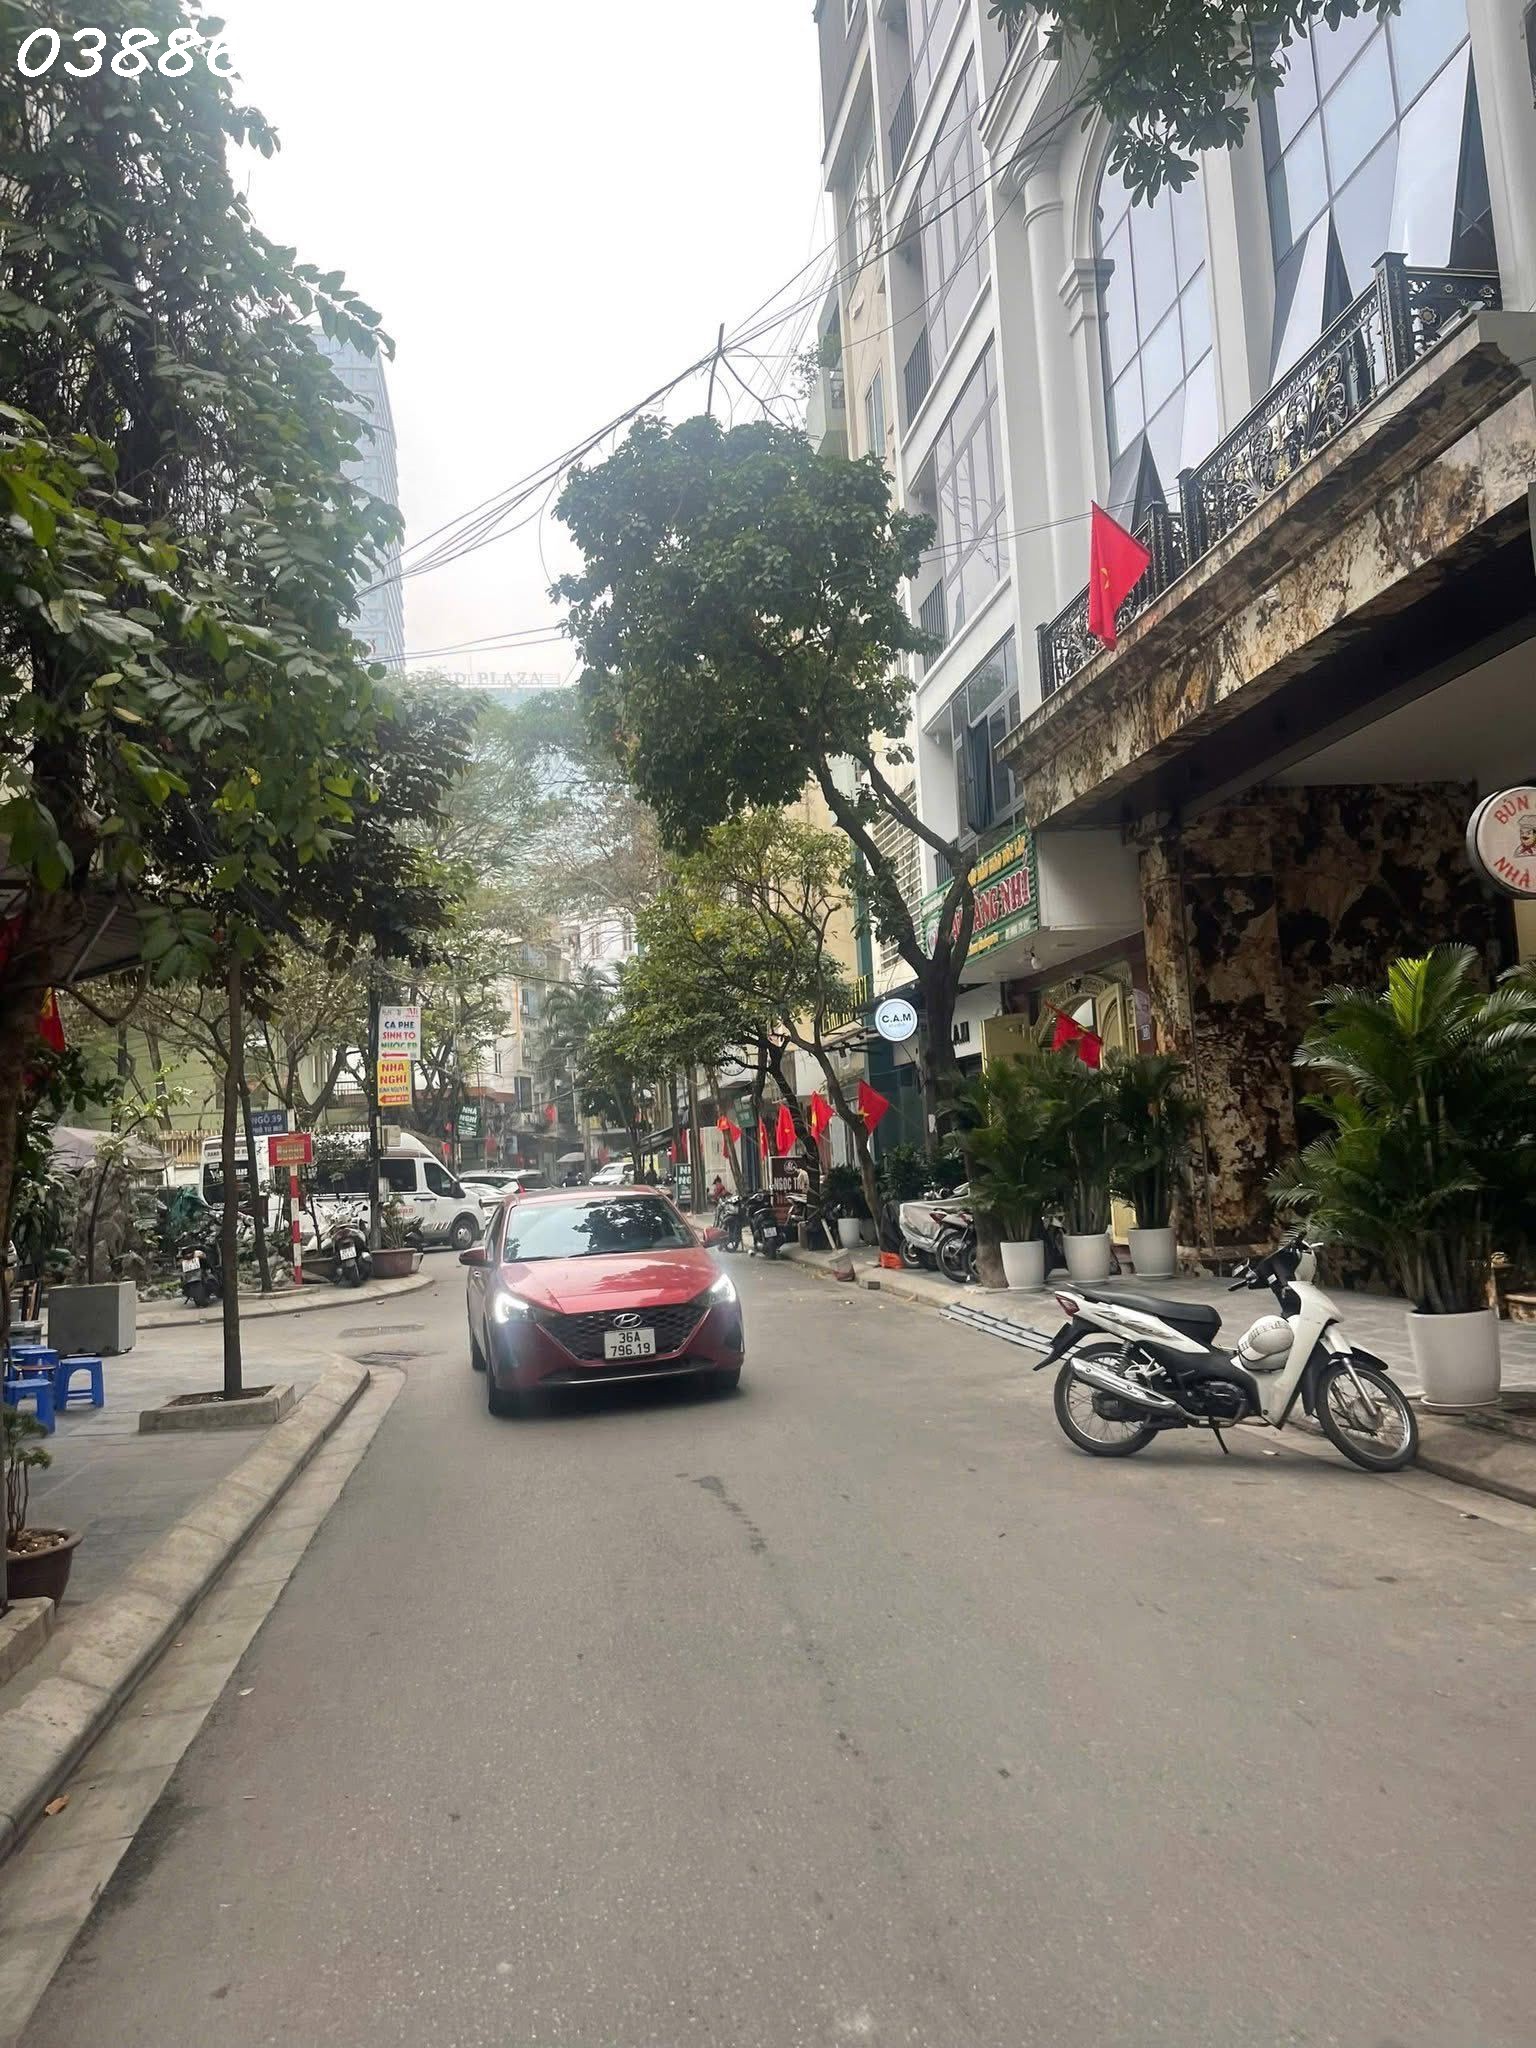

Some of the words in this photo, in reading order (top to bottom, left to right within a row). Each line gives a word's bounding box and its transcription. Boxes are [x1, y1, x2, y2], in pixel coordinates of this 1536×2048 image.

[478, 671, 541, 685] PLAZA
[881, 1013, 912, 1023] C.A.M
[619, 1331, 641, 1344] 36A
[610, 1342, 650, 1357] 796.19
